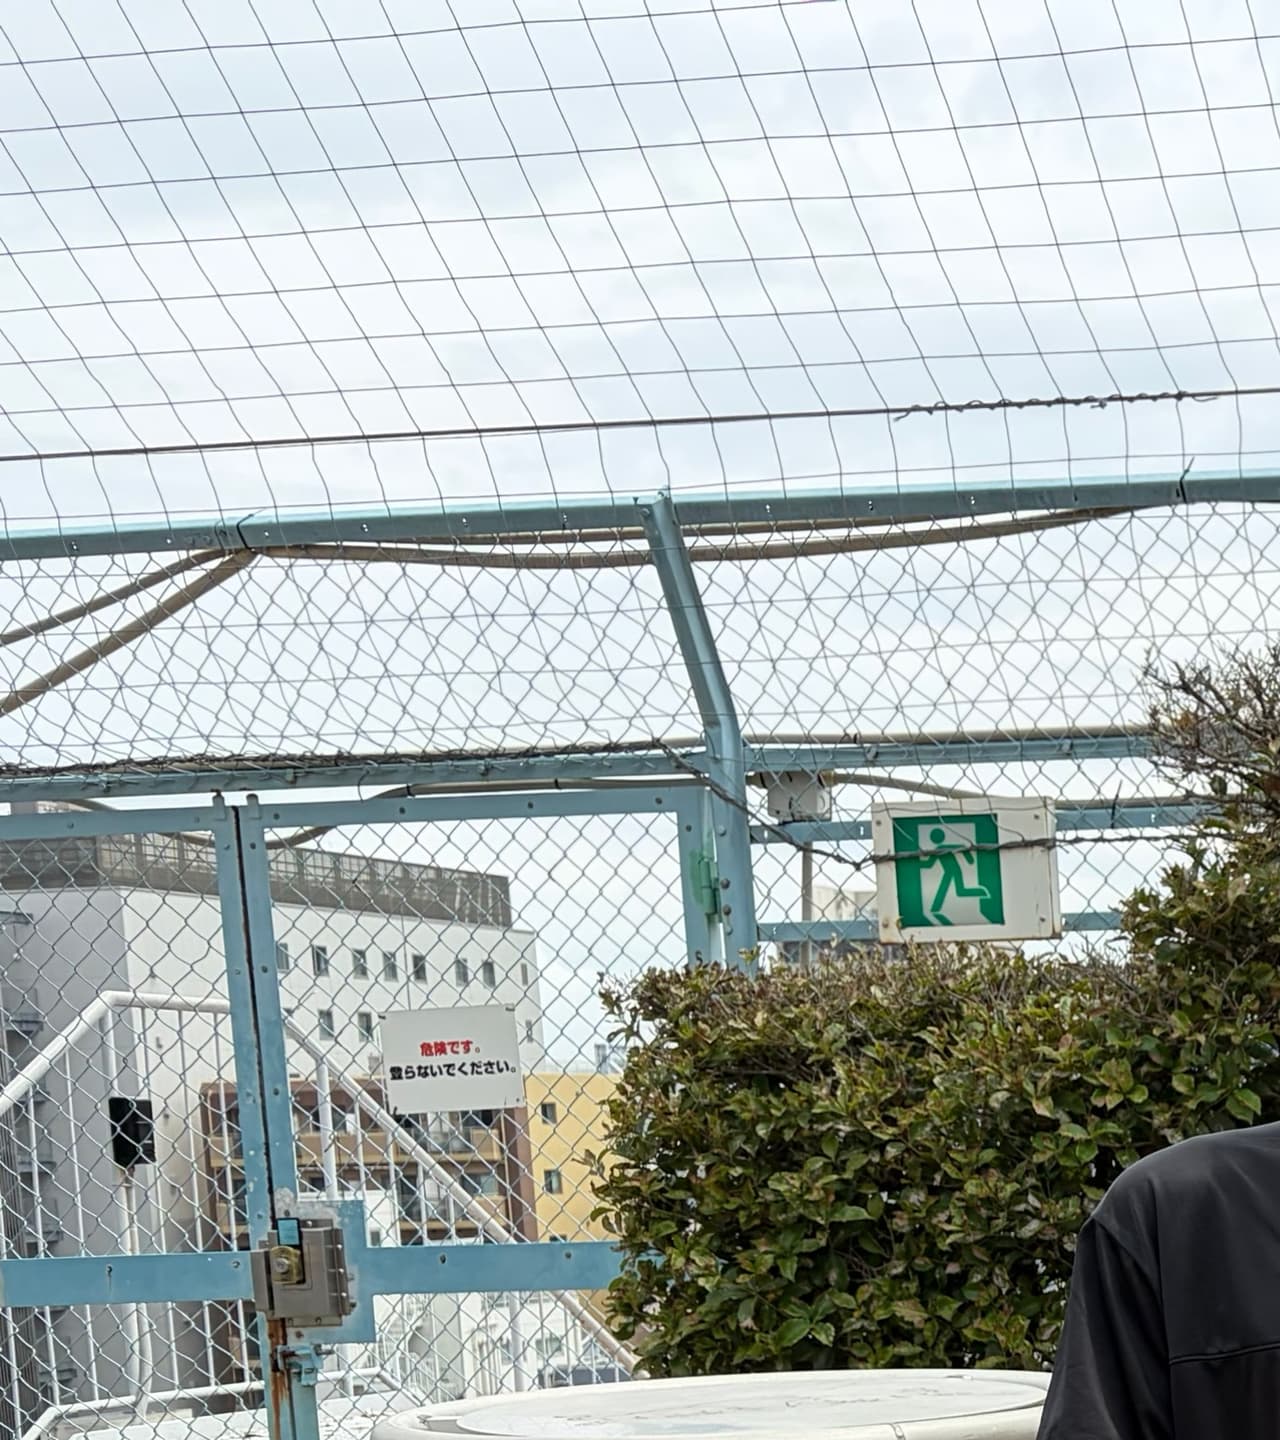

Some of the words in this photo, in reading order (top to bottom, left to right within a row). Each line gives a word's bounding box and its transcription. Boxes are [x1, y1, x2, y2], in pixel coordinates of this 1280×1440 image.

[420, 1040, 481, 1057] 危険です。
[389, 1060, 517, 1081] 登らないでください。
